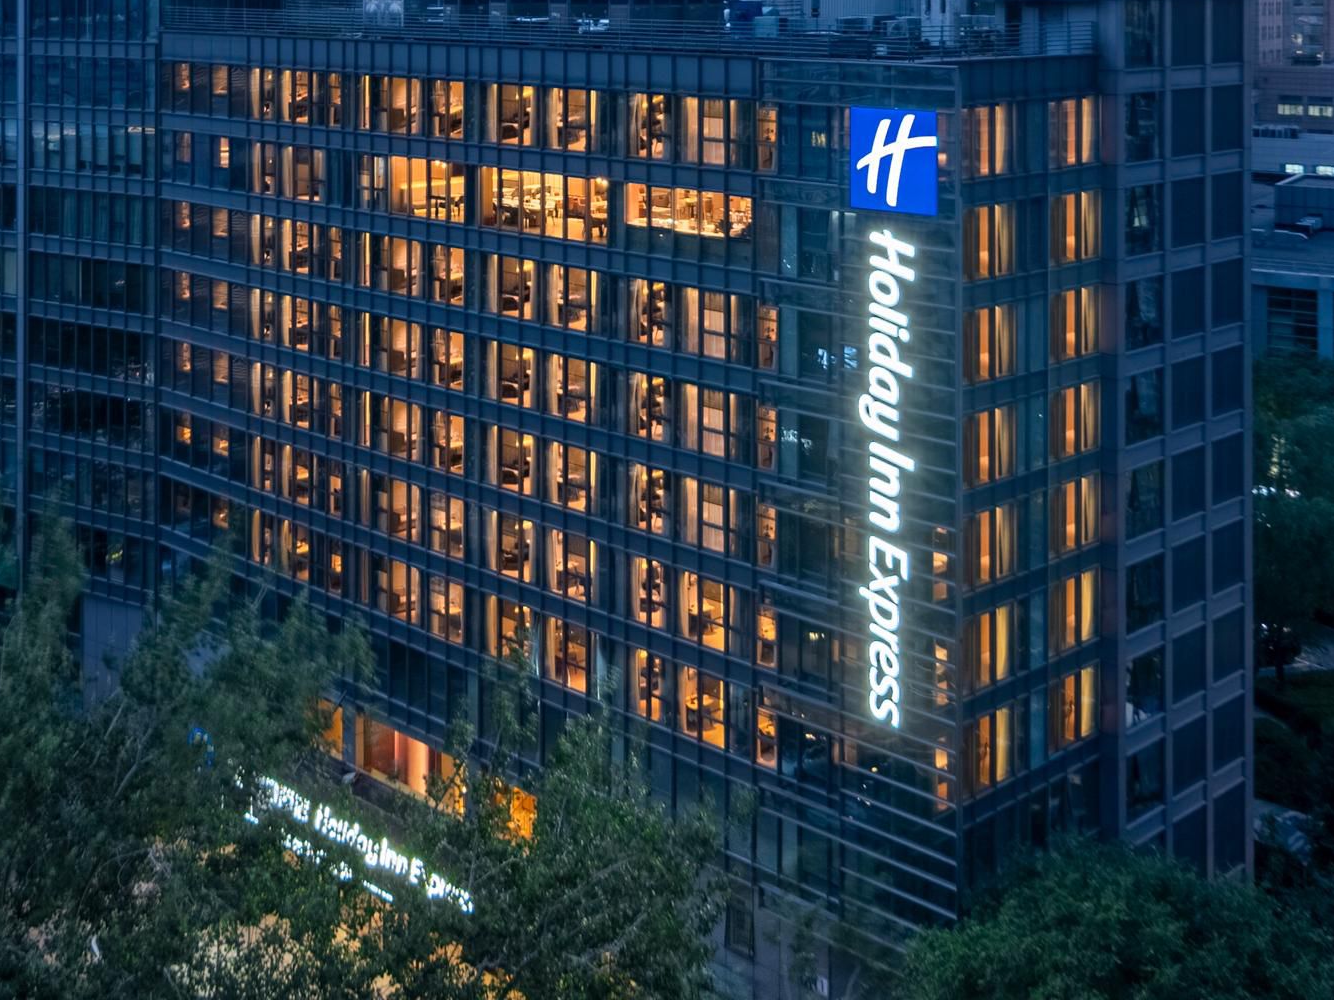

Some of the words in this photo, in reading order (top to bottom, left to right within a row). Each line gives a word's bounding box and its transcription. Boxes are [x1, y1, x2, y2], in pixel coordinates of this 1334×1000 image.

[858, 229, 916, 442] Holiday
[868, 441, 916, 532] Inn
[858, 535, 909, 728] Express
[314, 802, 380, 867] Holiday
[379, 837, 409, 875] Inn
